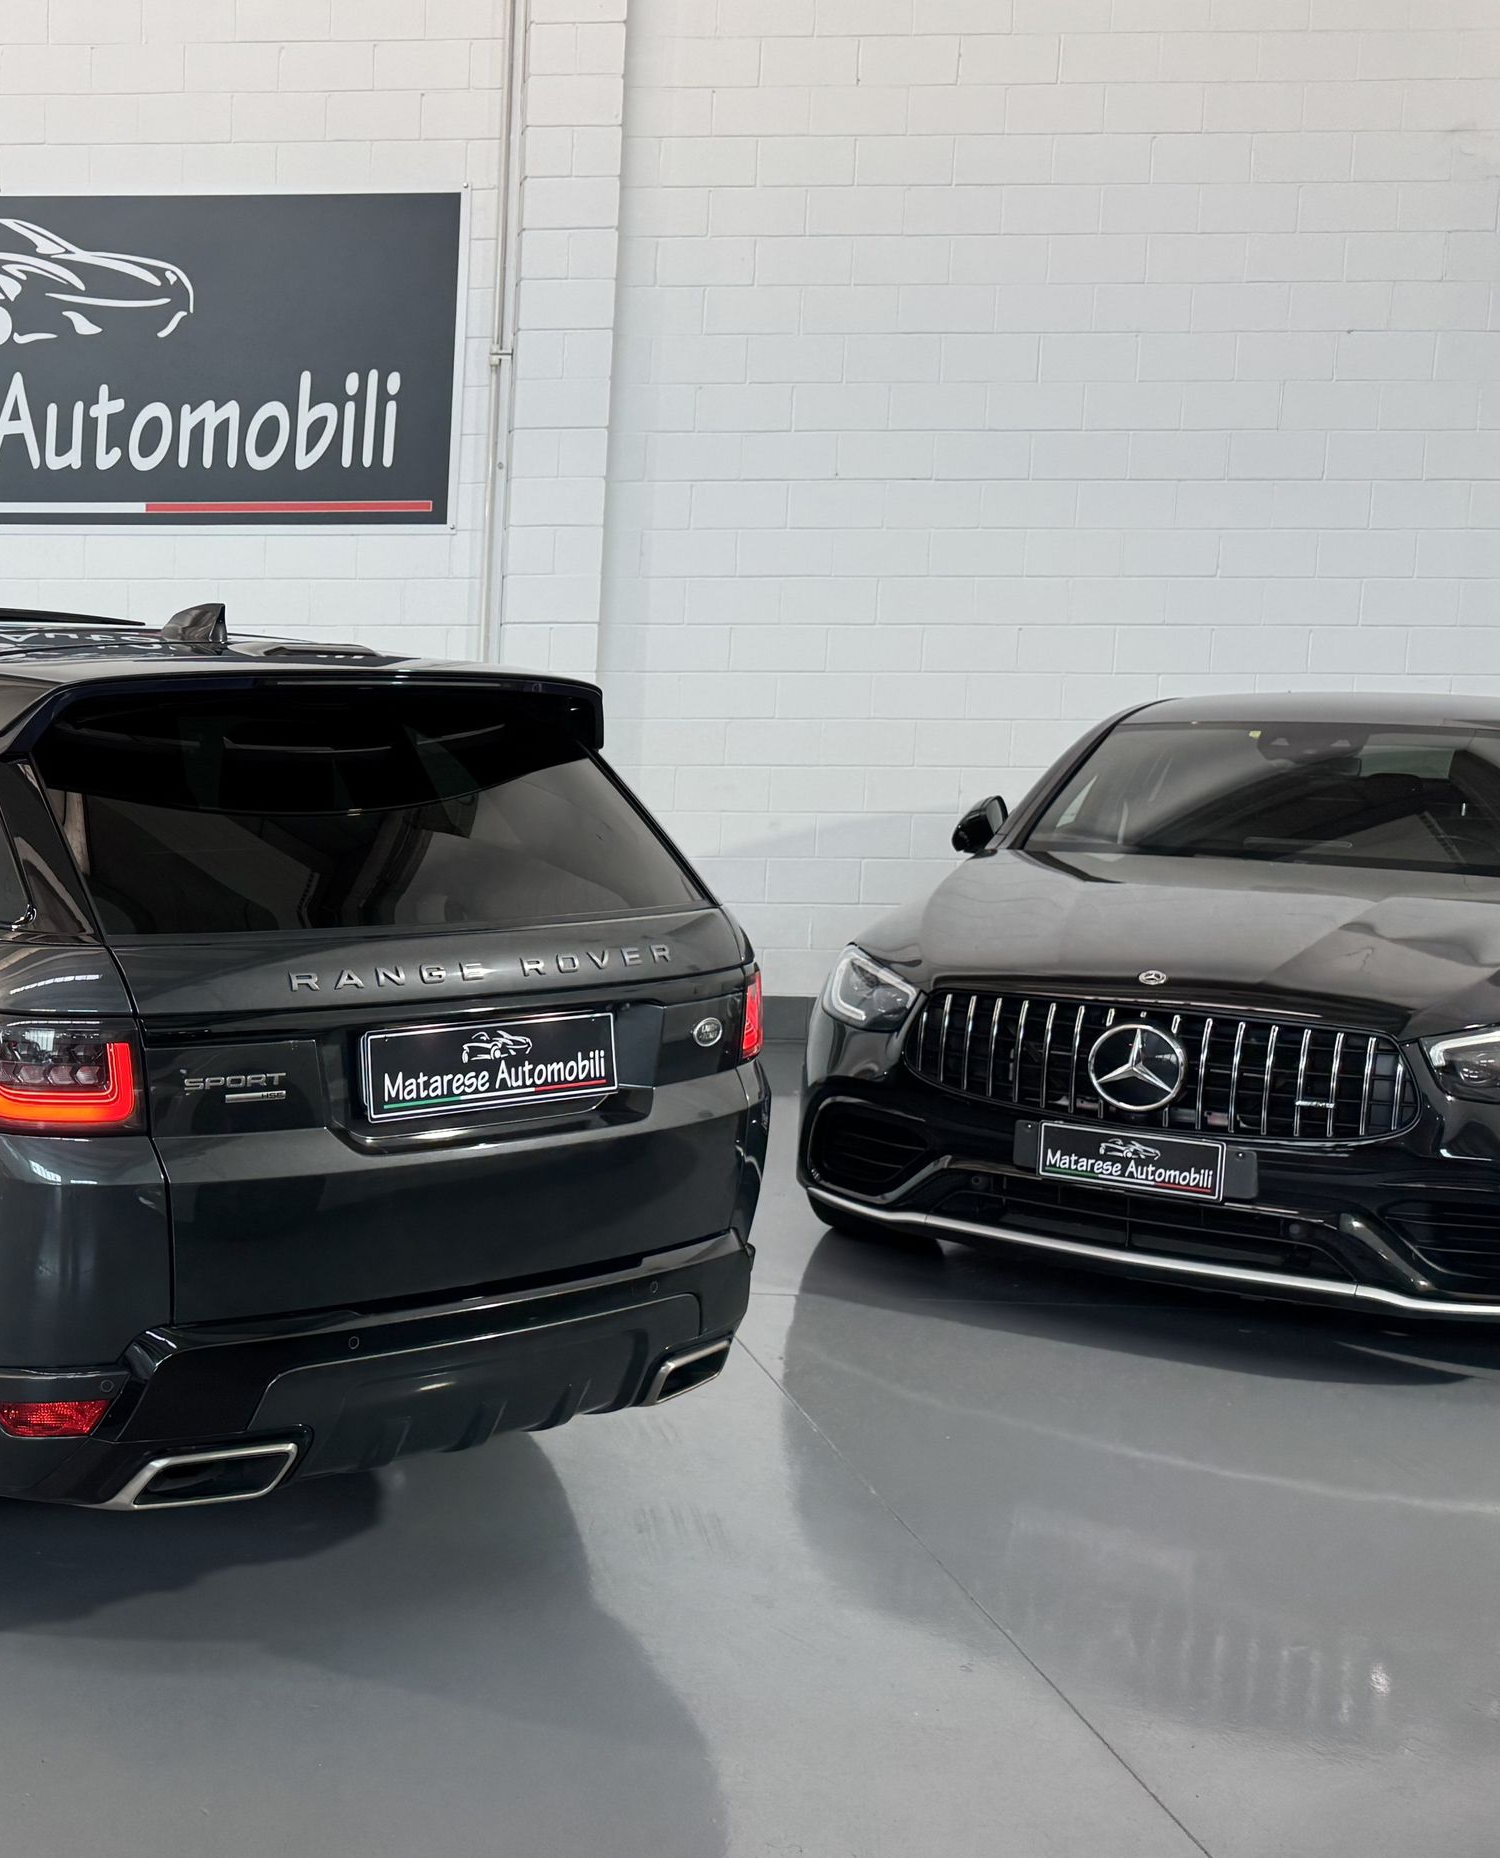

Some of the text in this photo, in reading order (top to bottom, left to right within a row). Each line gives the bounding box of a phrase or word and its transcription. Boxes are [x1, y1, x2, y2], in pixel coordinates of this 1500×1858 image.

[289, 943, 673, 992] RANGE ROVER
[184, 1073, 286, 1090] SPORT
[384, 1050, 606, 1101] Matarese Automobili
[1046, 1149, 1213, 1188] Matarese Automobili
